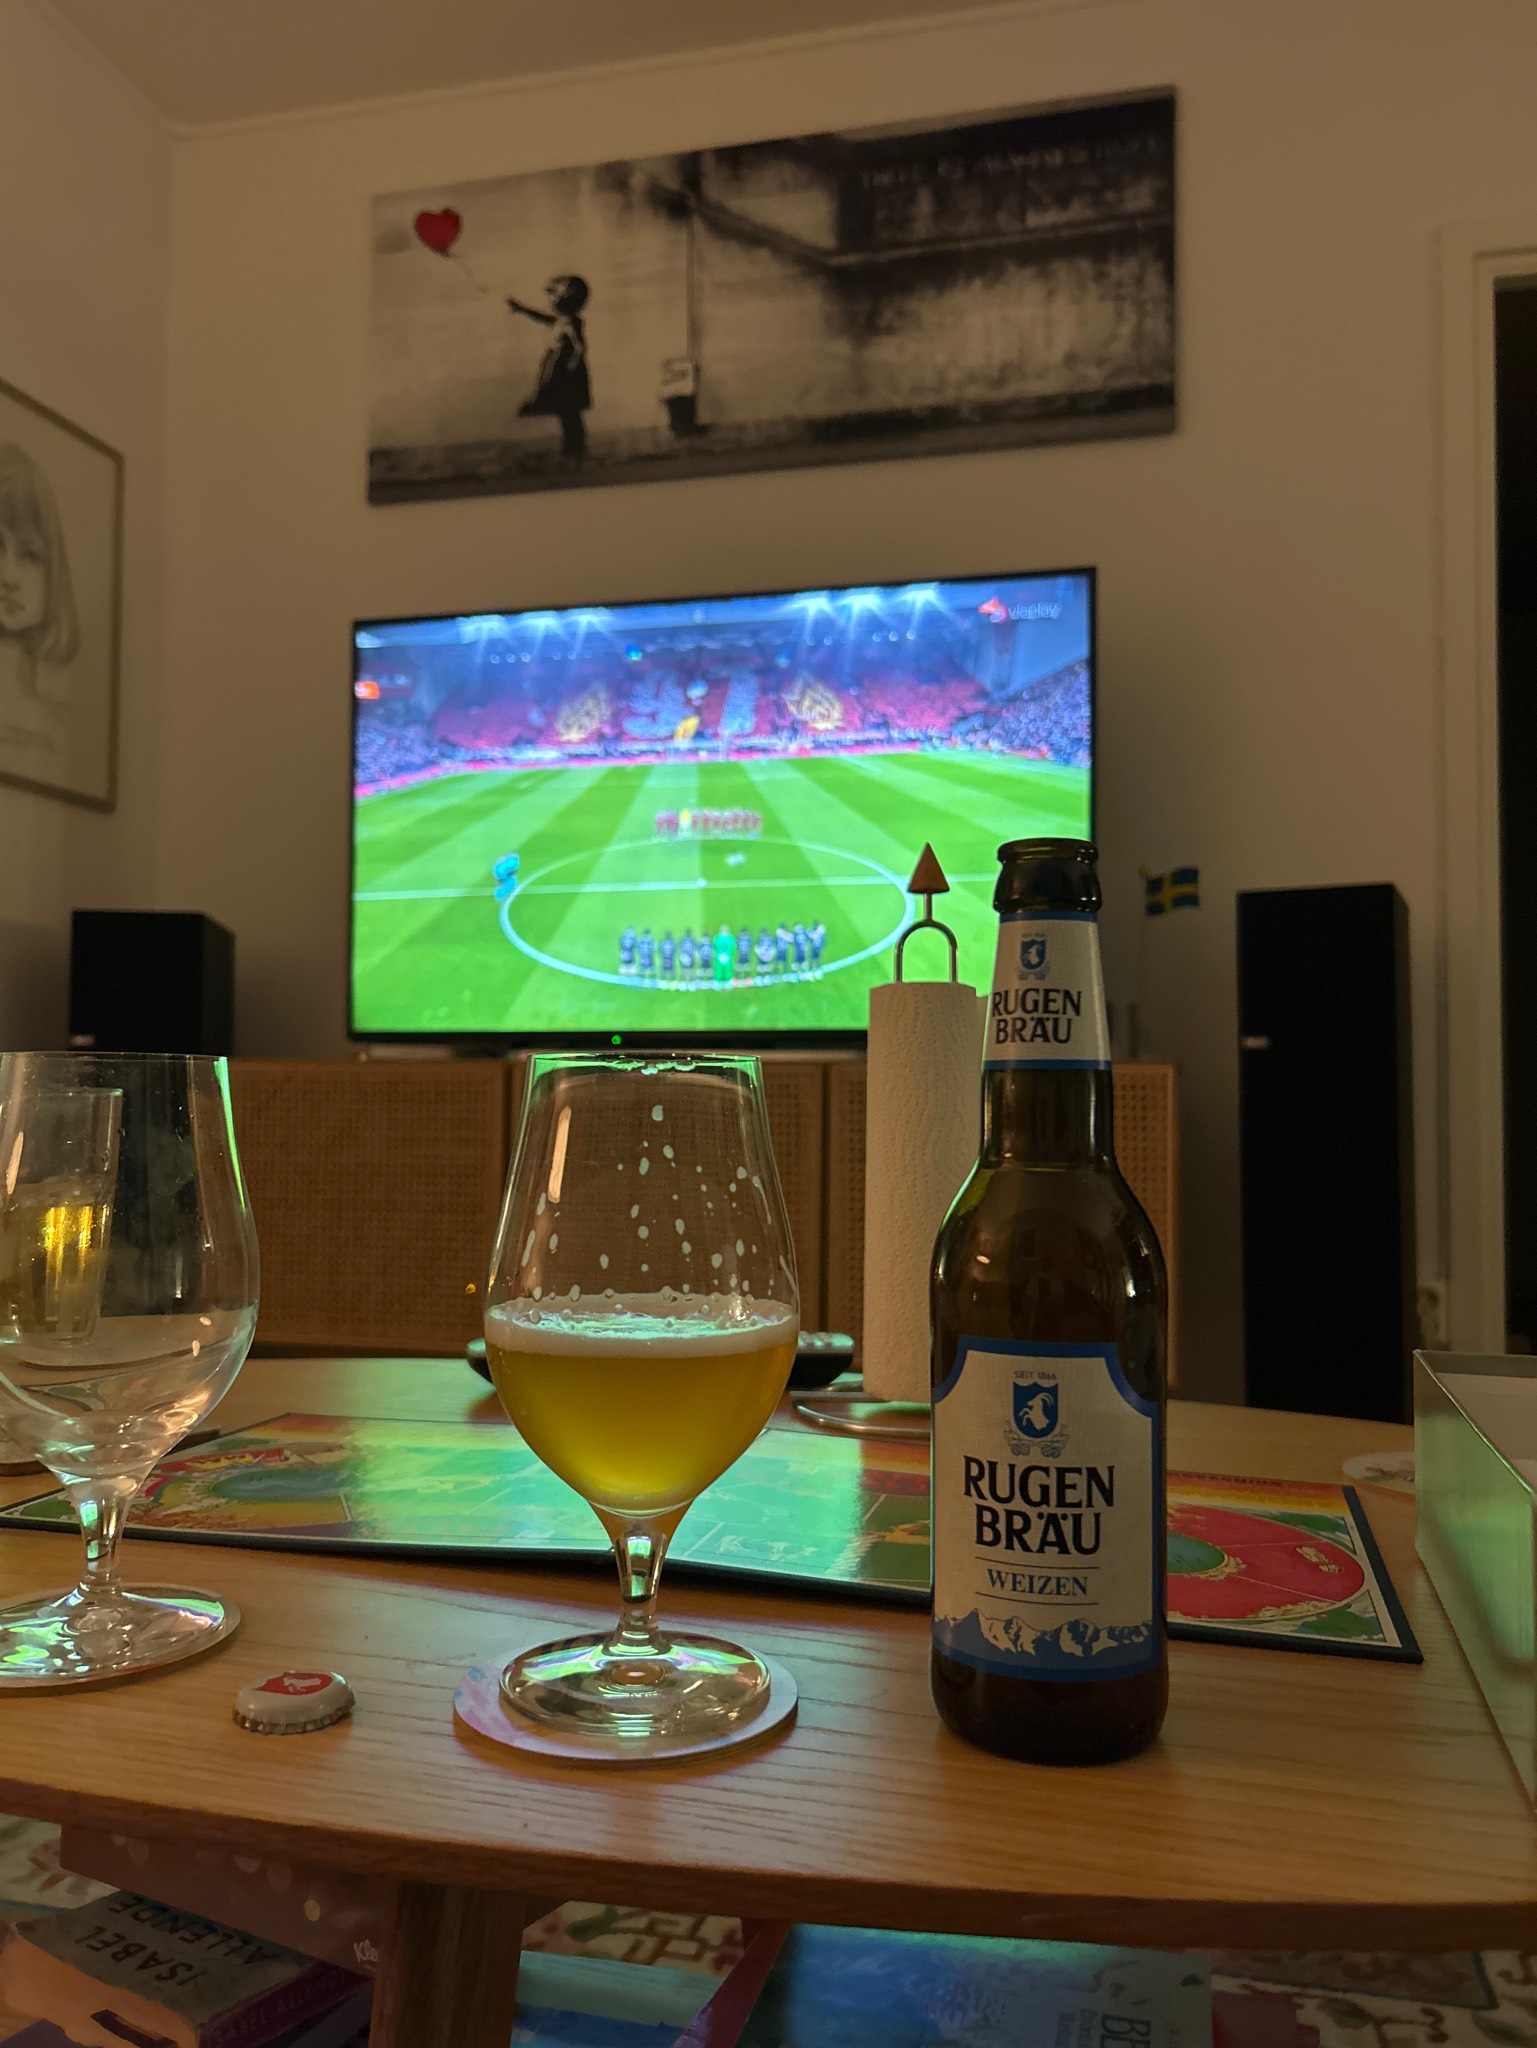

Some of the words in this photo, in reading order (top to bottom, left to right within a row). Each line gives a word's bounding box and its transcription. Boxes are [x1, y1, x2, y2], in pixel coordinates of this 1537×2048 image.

[991, 988, 1082, 1018] RUGEN
[995, 1016, 1073, 1045] BRÄU
[963, 1455, 1116, 1508] RUGEN
[975, 1503, 1101, 1555] BRÄU
[986, 1569, 1088, 1597] WEIZEN
[74, 1925, 206, 1986] ISABEL
[108, 1896, 280, 1964] ALLENDE
